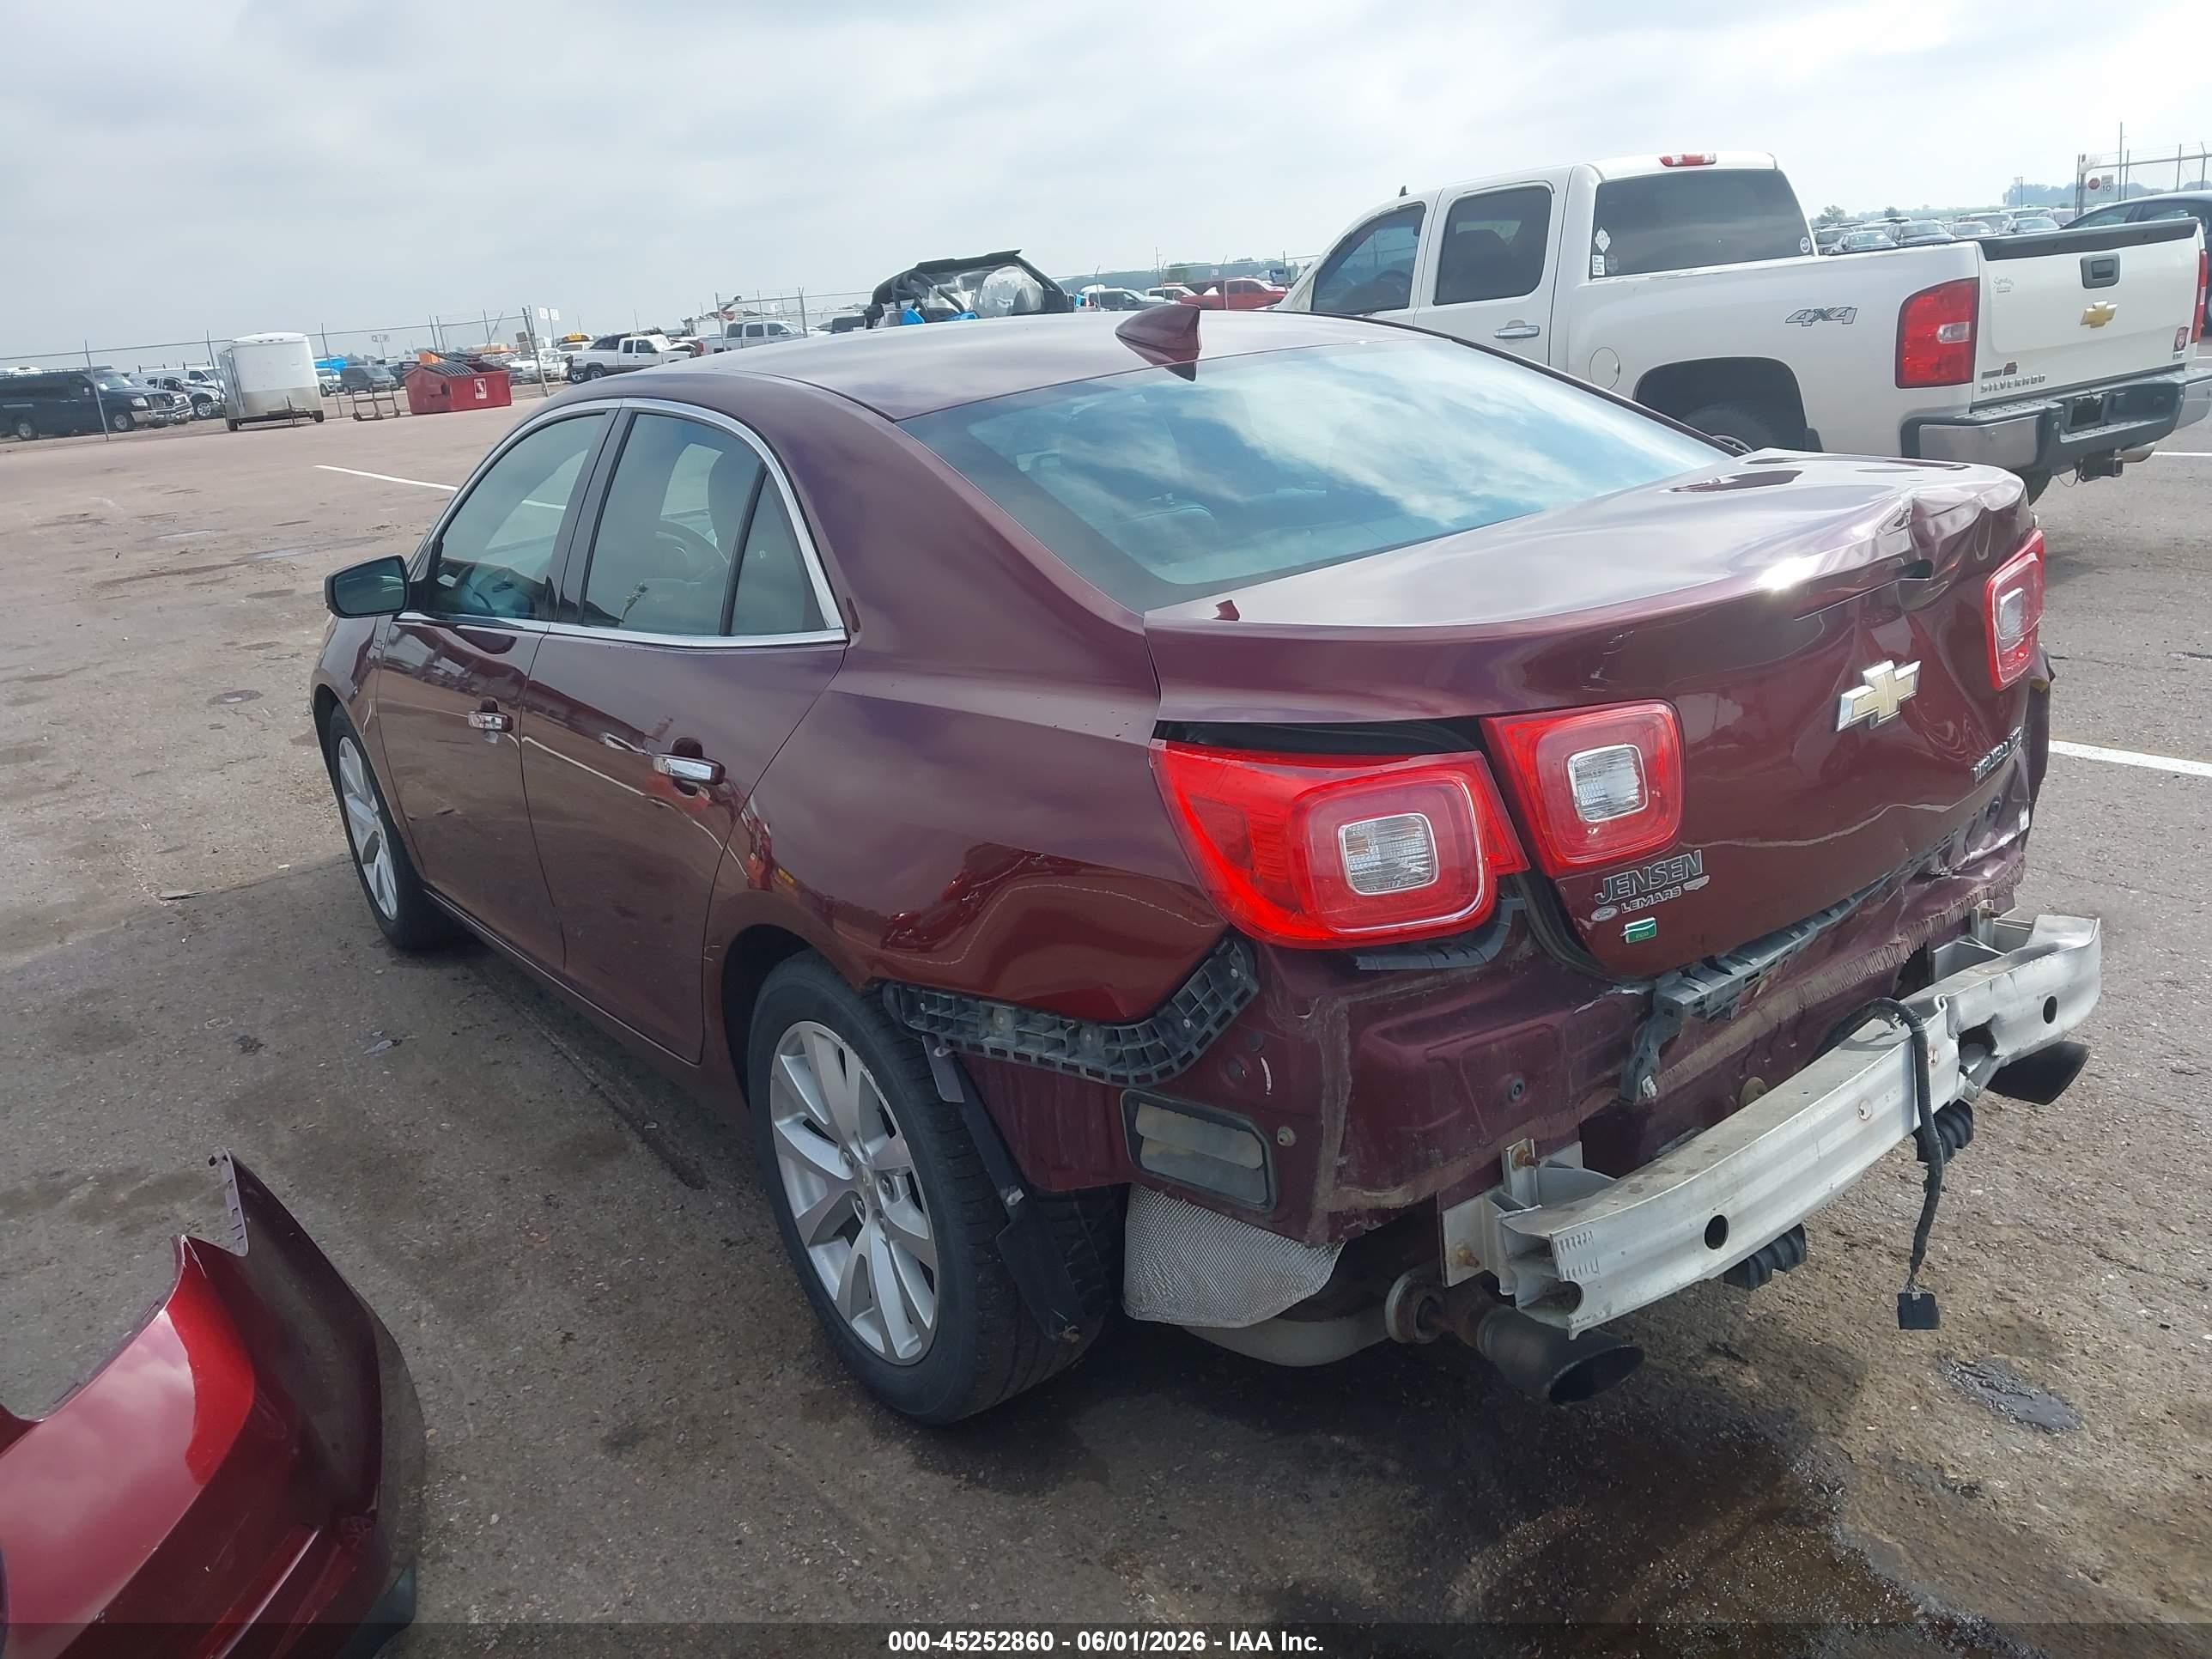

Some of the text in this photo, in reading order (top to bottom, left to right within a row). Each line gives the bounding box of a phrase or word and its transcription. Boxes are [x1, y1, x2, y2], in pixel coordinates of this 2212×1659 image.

[1980, 374, 2046, 393] SILVERADO
[1595, 849, 1703, 905] JENSEN
[1621, 886, 1682, 914] LEMARS
[1635, 931, 1650, 939] eco
